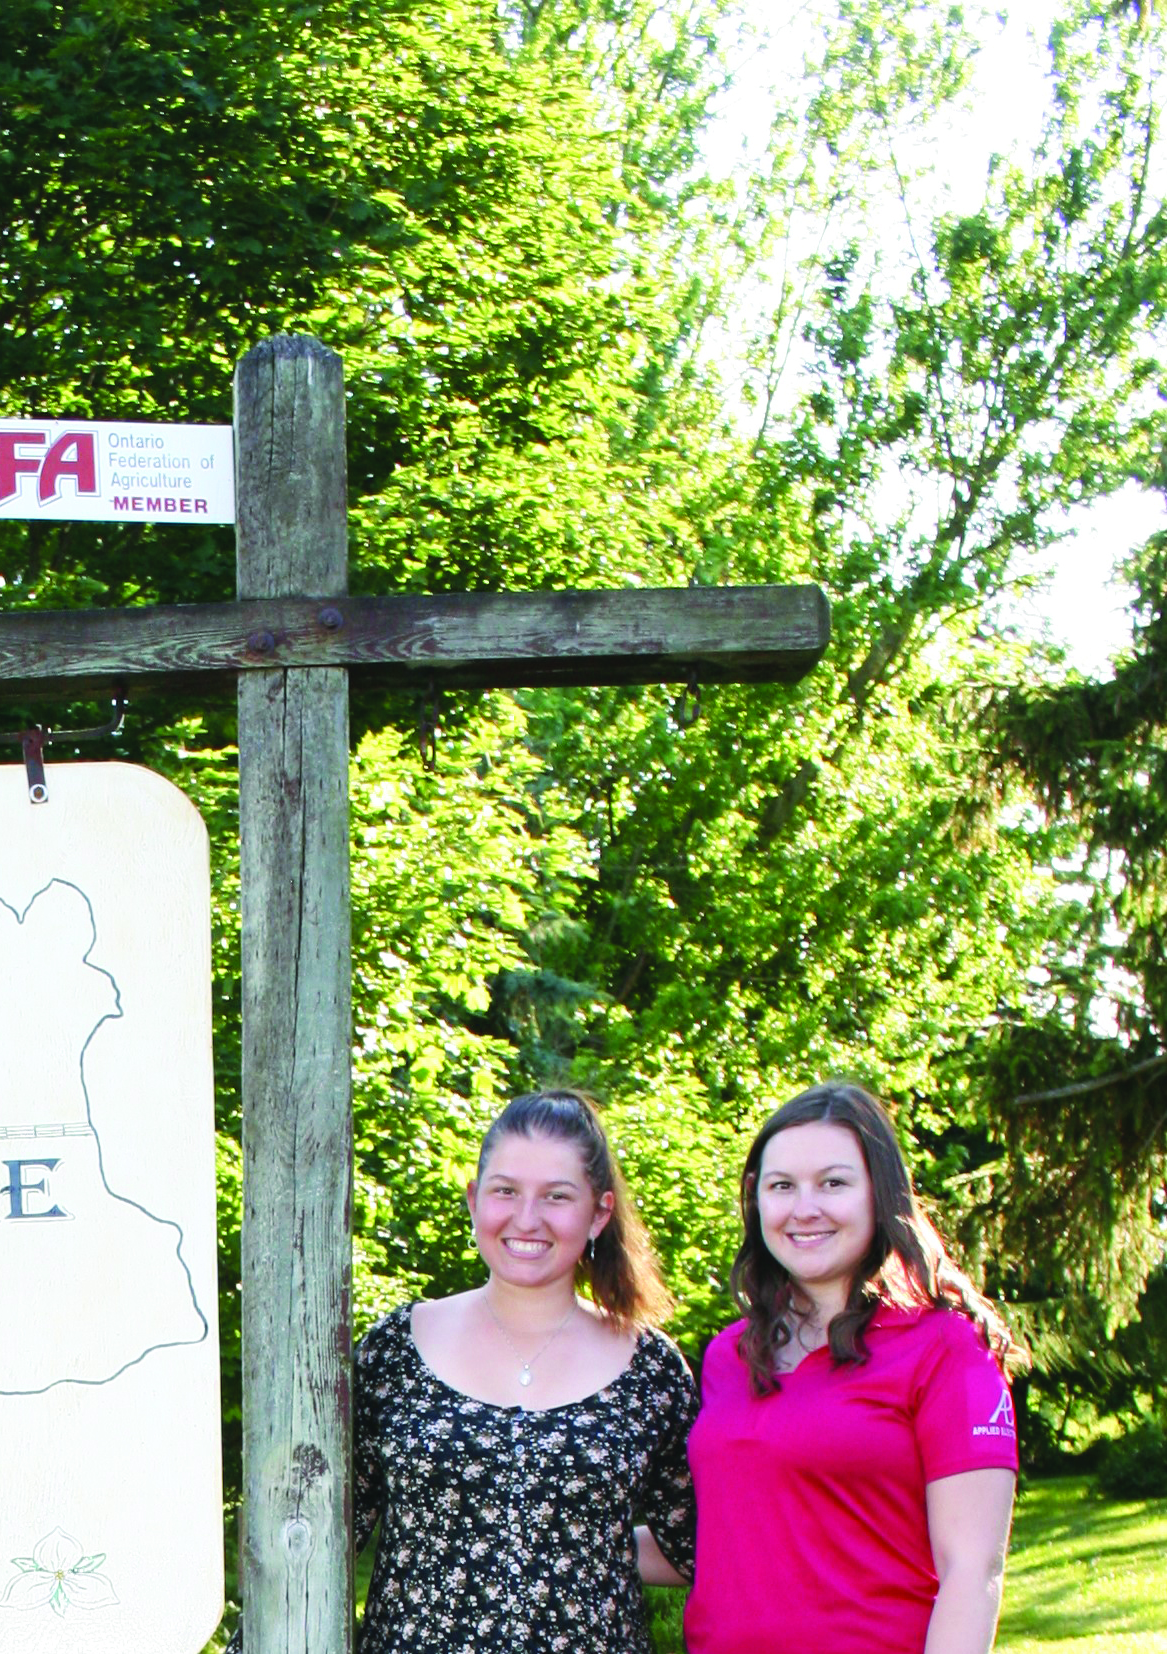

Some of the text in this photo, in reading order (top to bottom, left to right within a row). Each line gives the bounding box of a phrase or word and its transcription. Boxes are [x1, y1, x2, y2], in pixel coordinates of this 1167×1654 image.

[108, 432, 164, 449] Ontario
[108, 452, 215, 470] Federation of
[111, 472, 193, 490] Agriculture
[113, 496, 208, 514] MEMBER
